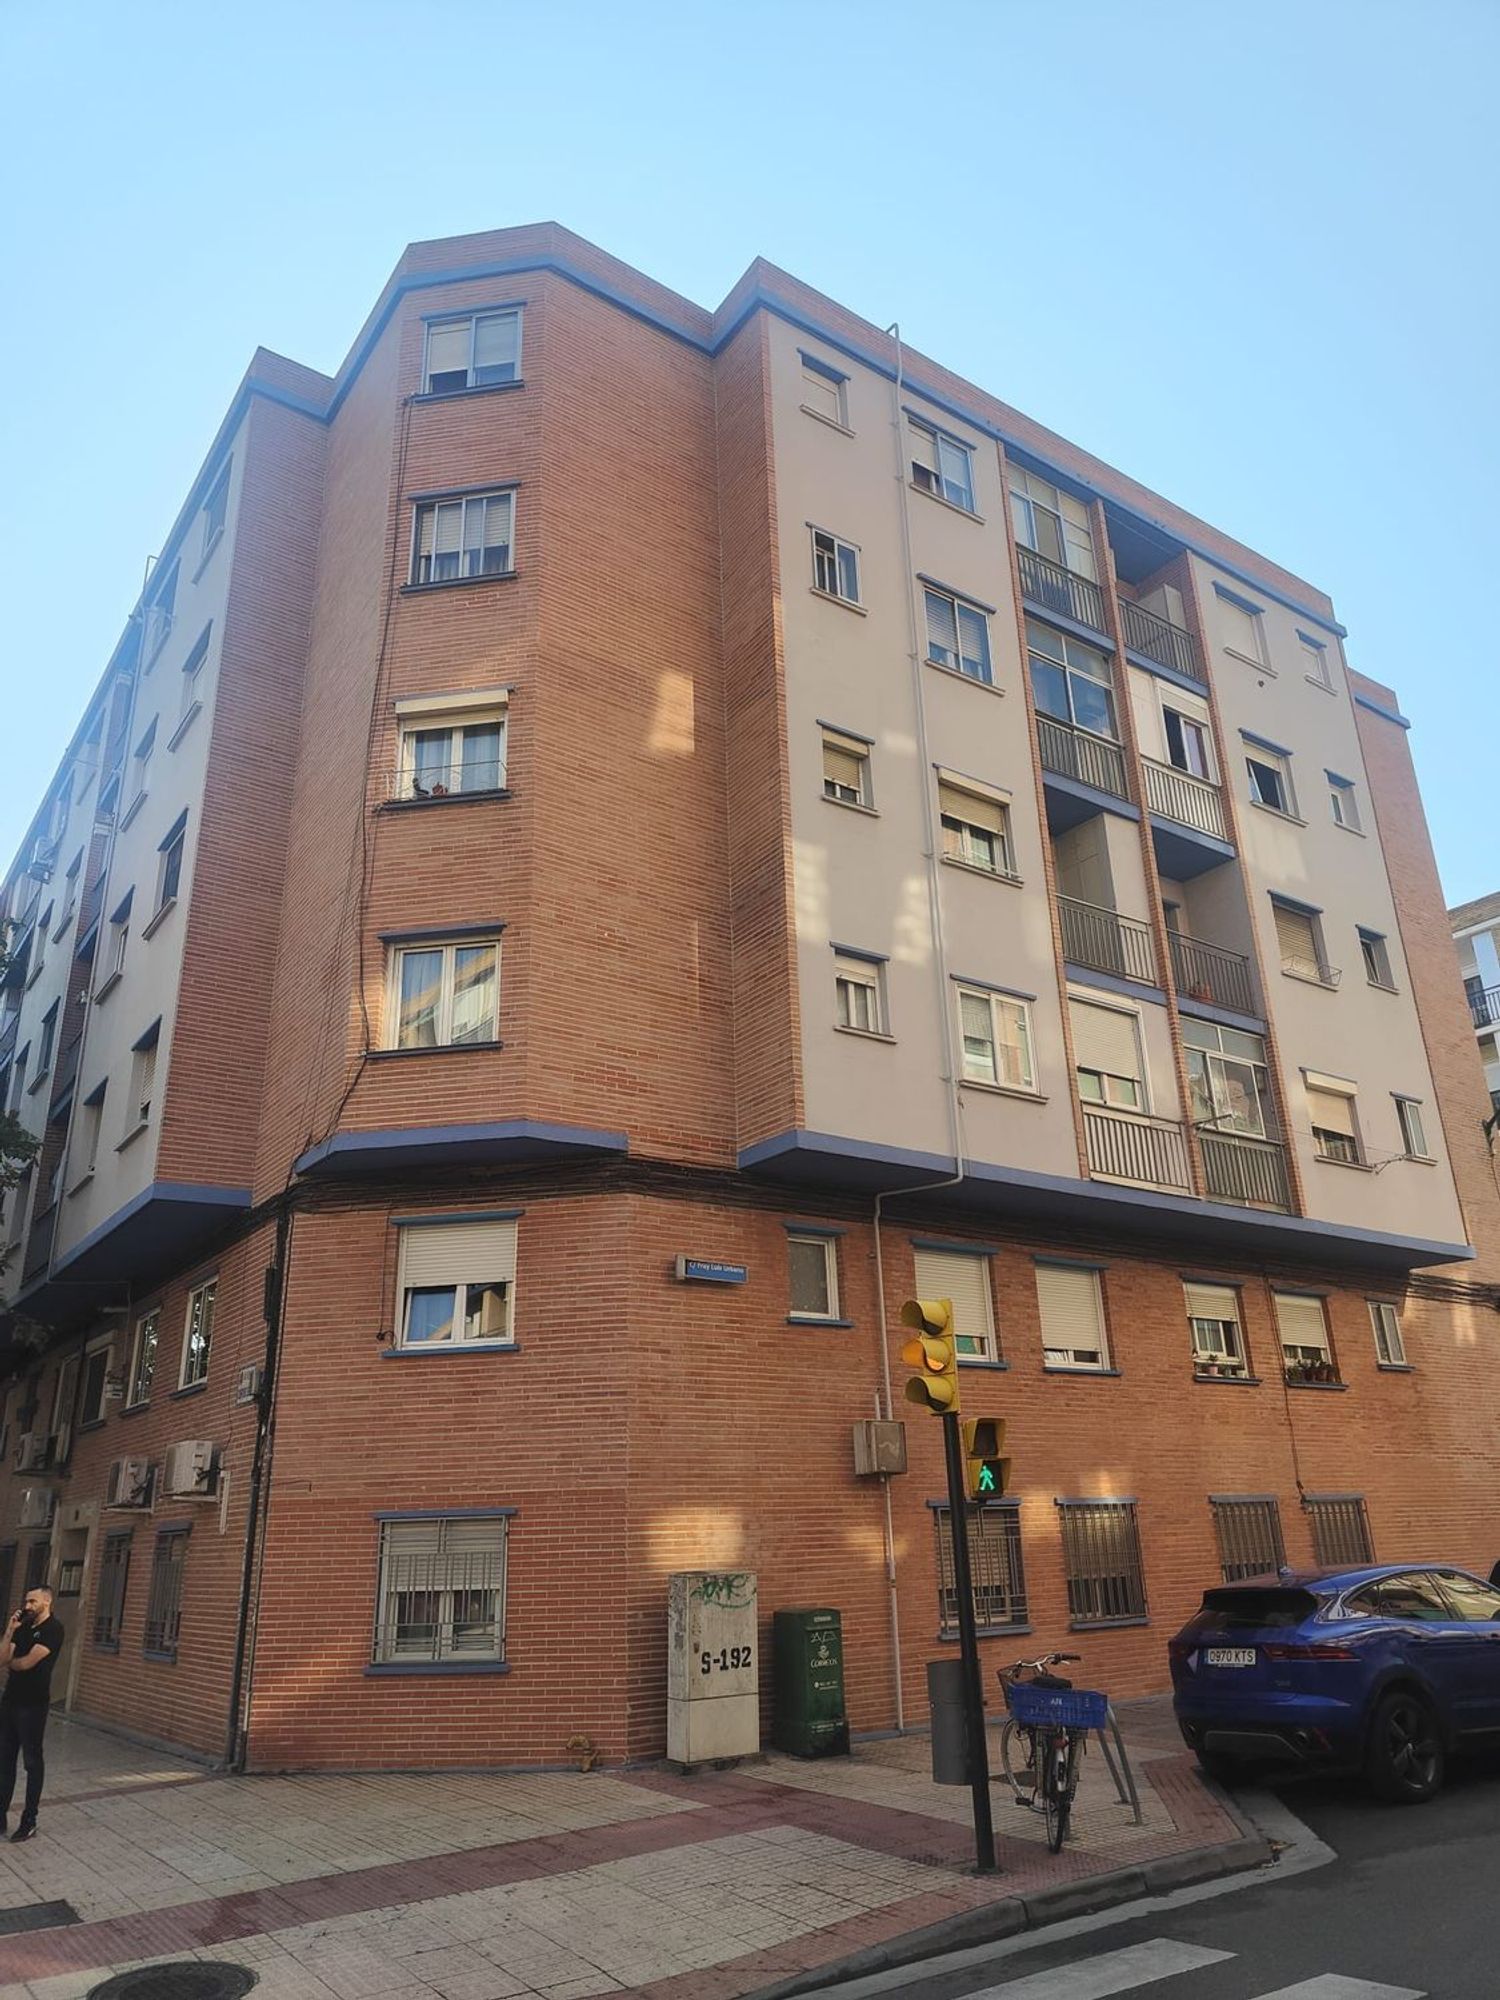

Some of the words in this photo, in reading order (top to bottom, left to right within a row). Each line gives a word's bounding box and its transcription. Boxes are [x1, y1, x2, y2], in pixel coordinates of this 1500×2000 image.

[701, 1646, 751, 1675] S-192
[1209, 1651, 1232, 1662] 0970
[1234, 1651, 1254, 1663] KTS
